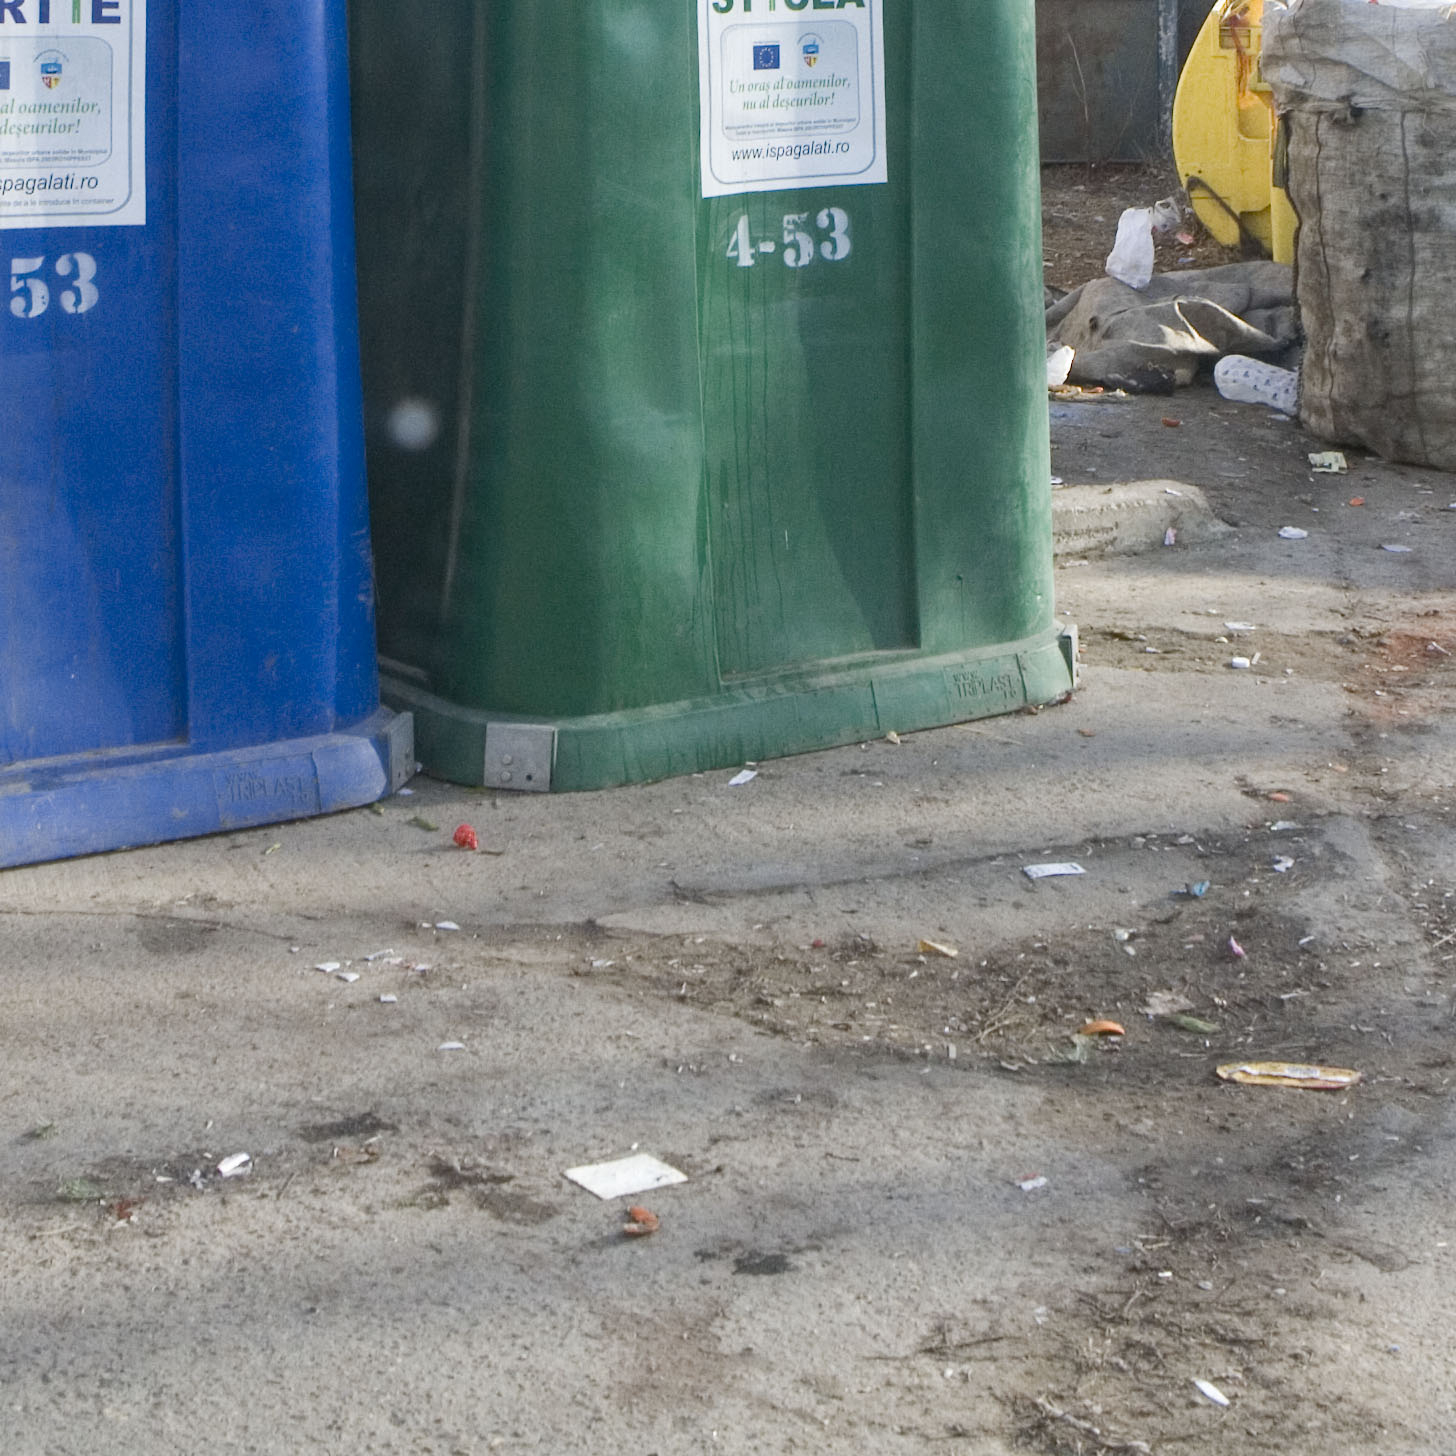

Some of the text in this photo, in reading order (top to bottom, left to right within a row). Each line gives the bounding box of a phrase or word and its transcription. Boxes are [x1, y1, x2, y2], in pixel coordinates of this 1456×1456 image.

[729, 79, 745, 94] Un
[773, 75, 785, 91] al
[0, 98, 16, 115] al
[18, 98, 102, 116] oamenilor,
[742, 100, 756, 111] nu
[759, 94, 770, 110] al
[731, 139, 850, 161] www.ispagalati.ro
[725, 206, 852, 267] 4-53
